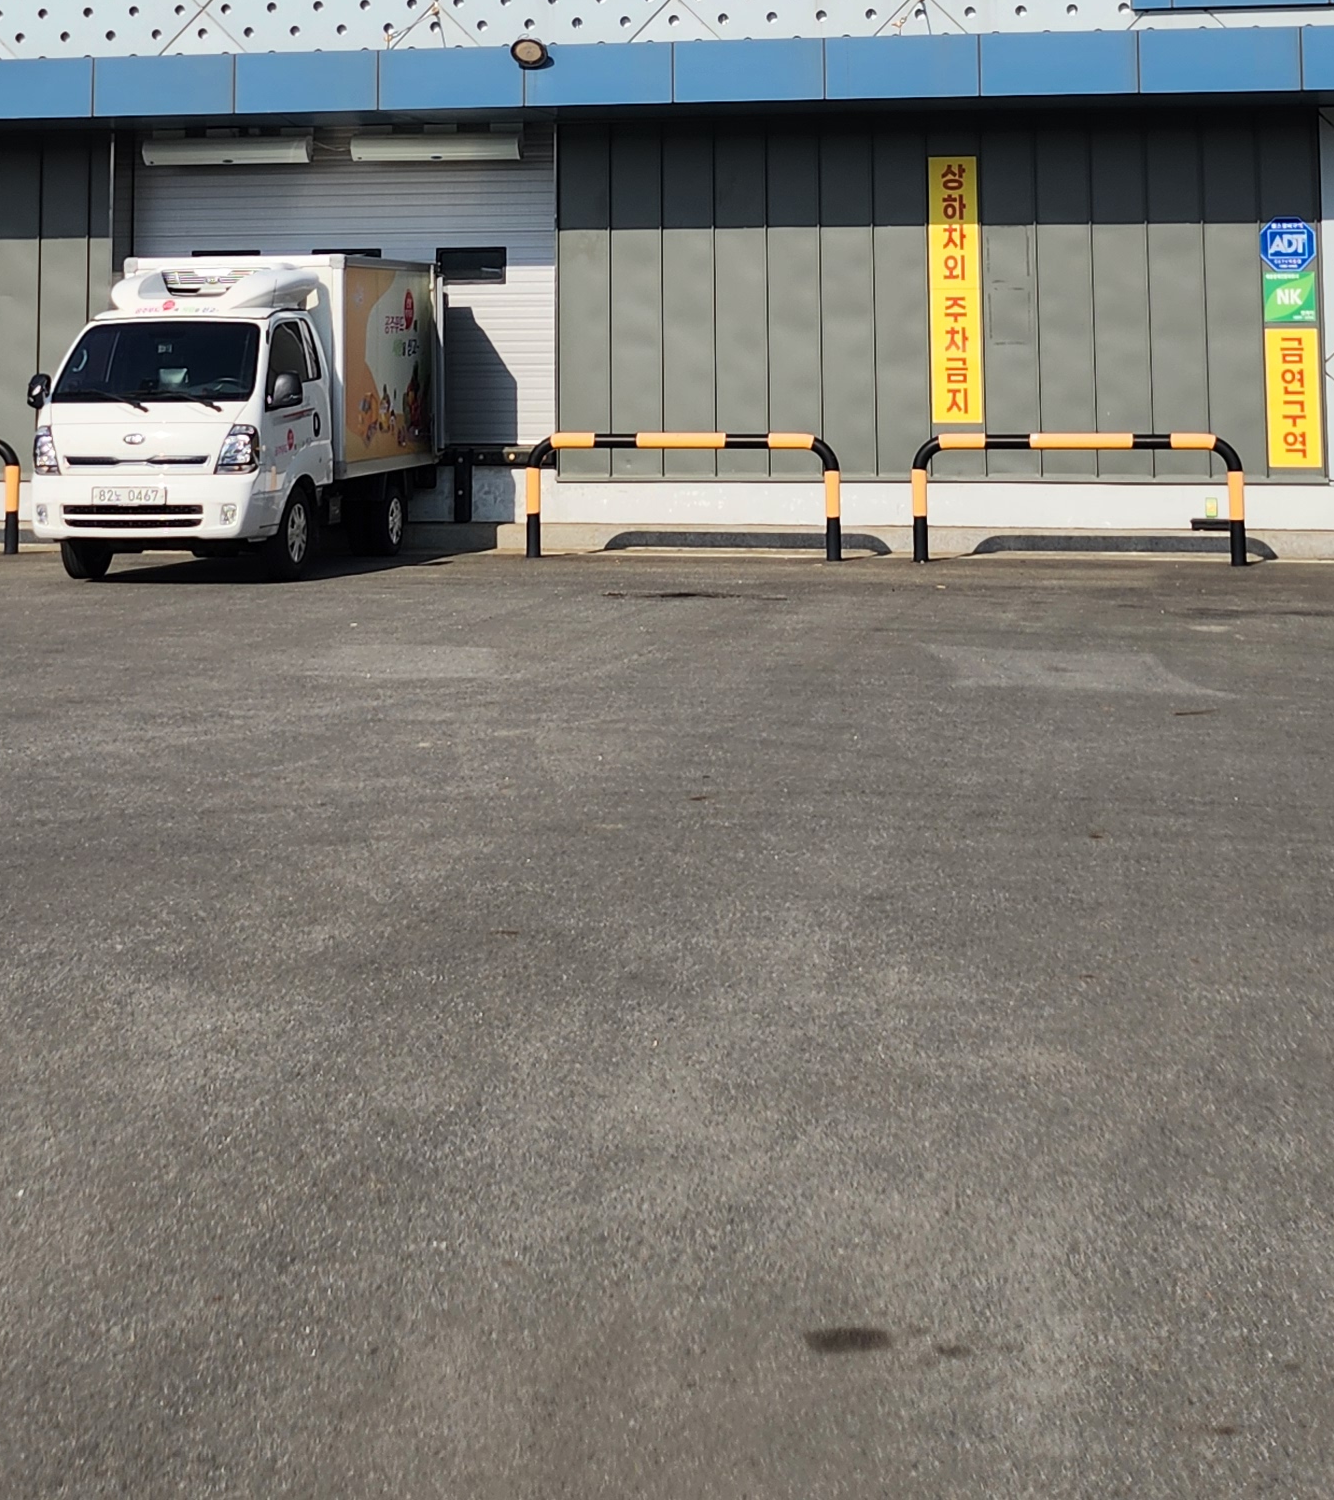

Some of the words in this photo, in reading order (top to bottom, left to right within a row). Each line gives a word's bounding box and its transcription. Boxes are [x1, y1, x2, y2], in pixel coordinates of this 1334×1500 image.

[1269, 234, 1307, 254] ADT
[1276, 287, 1303, 306] NK
[1279, 337, 1308, 459] 금연구역
[127, 489, 160, 502] 0467
